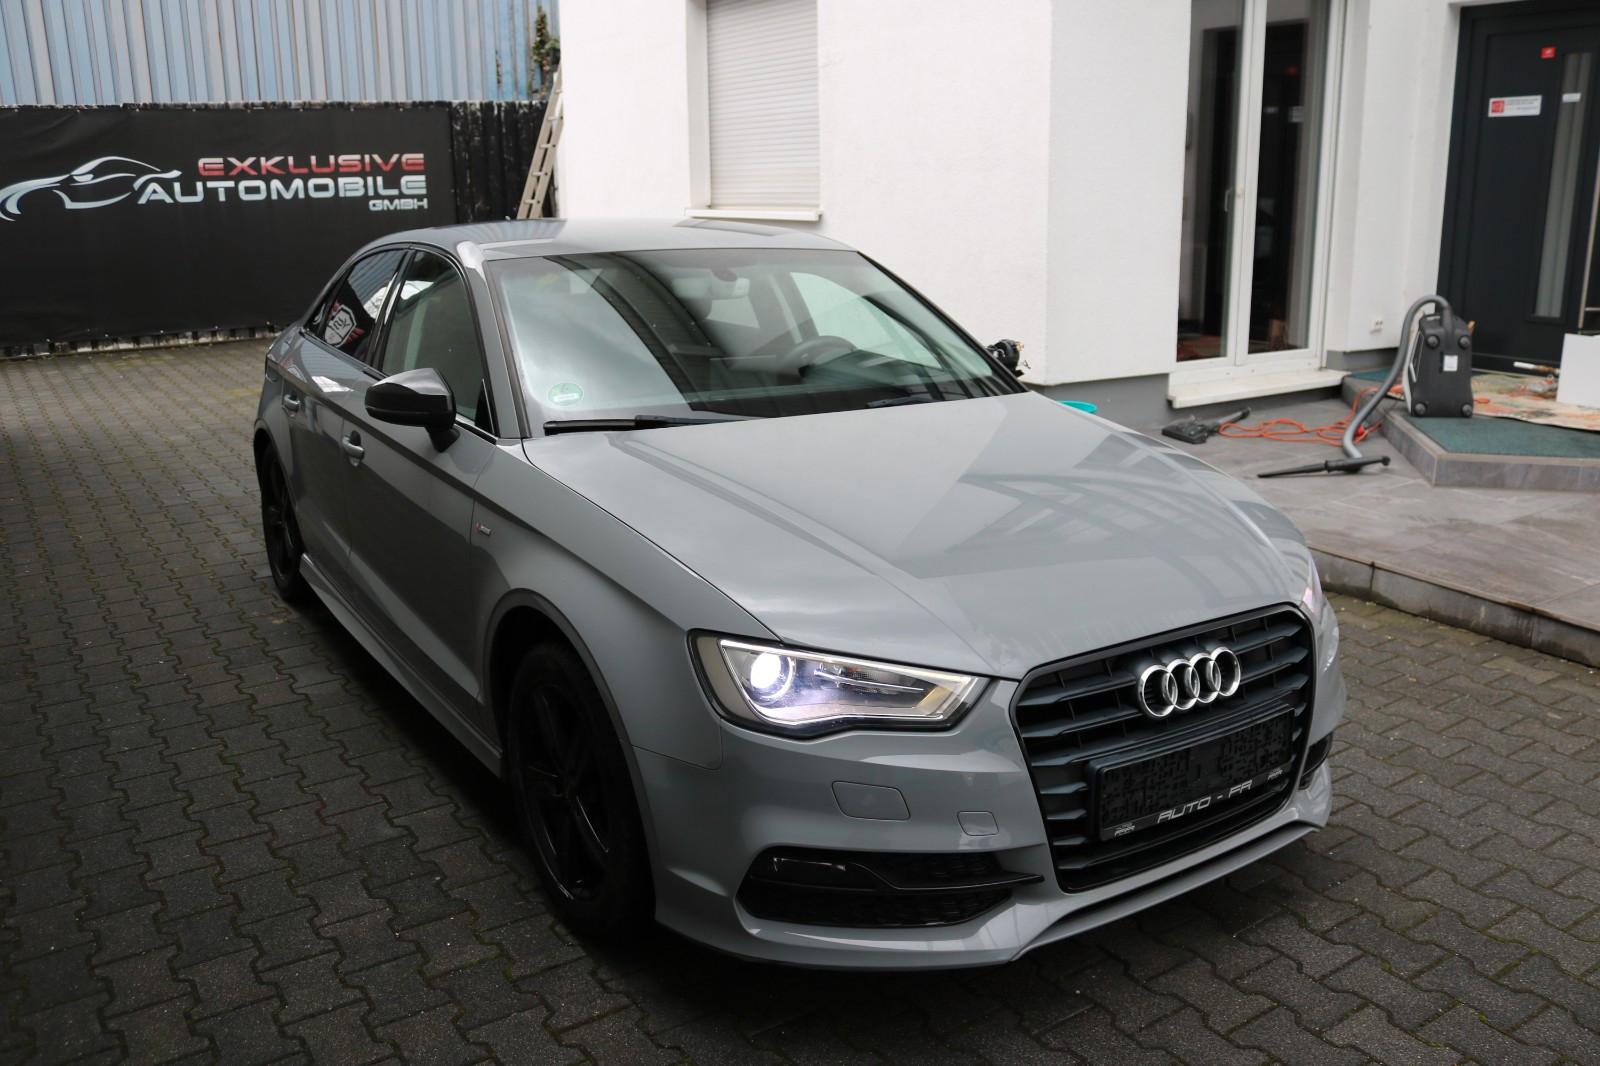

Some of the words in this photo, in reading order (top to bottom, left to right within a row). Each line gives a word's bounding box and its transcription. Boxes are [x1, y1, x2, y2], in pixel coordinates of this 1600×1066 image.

[198, 153, 425, 176] EXKLUSIVE
[137, 175, 428, 205] AUTOMOBILE
[368, 198, 428, 212] GMBH
[1157, 796, 1212, 824] AUTO
